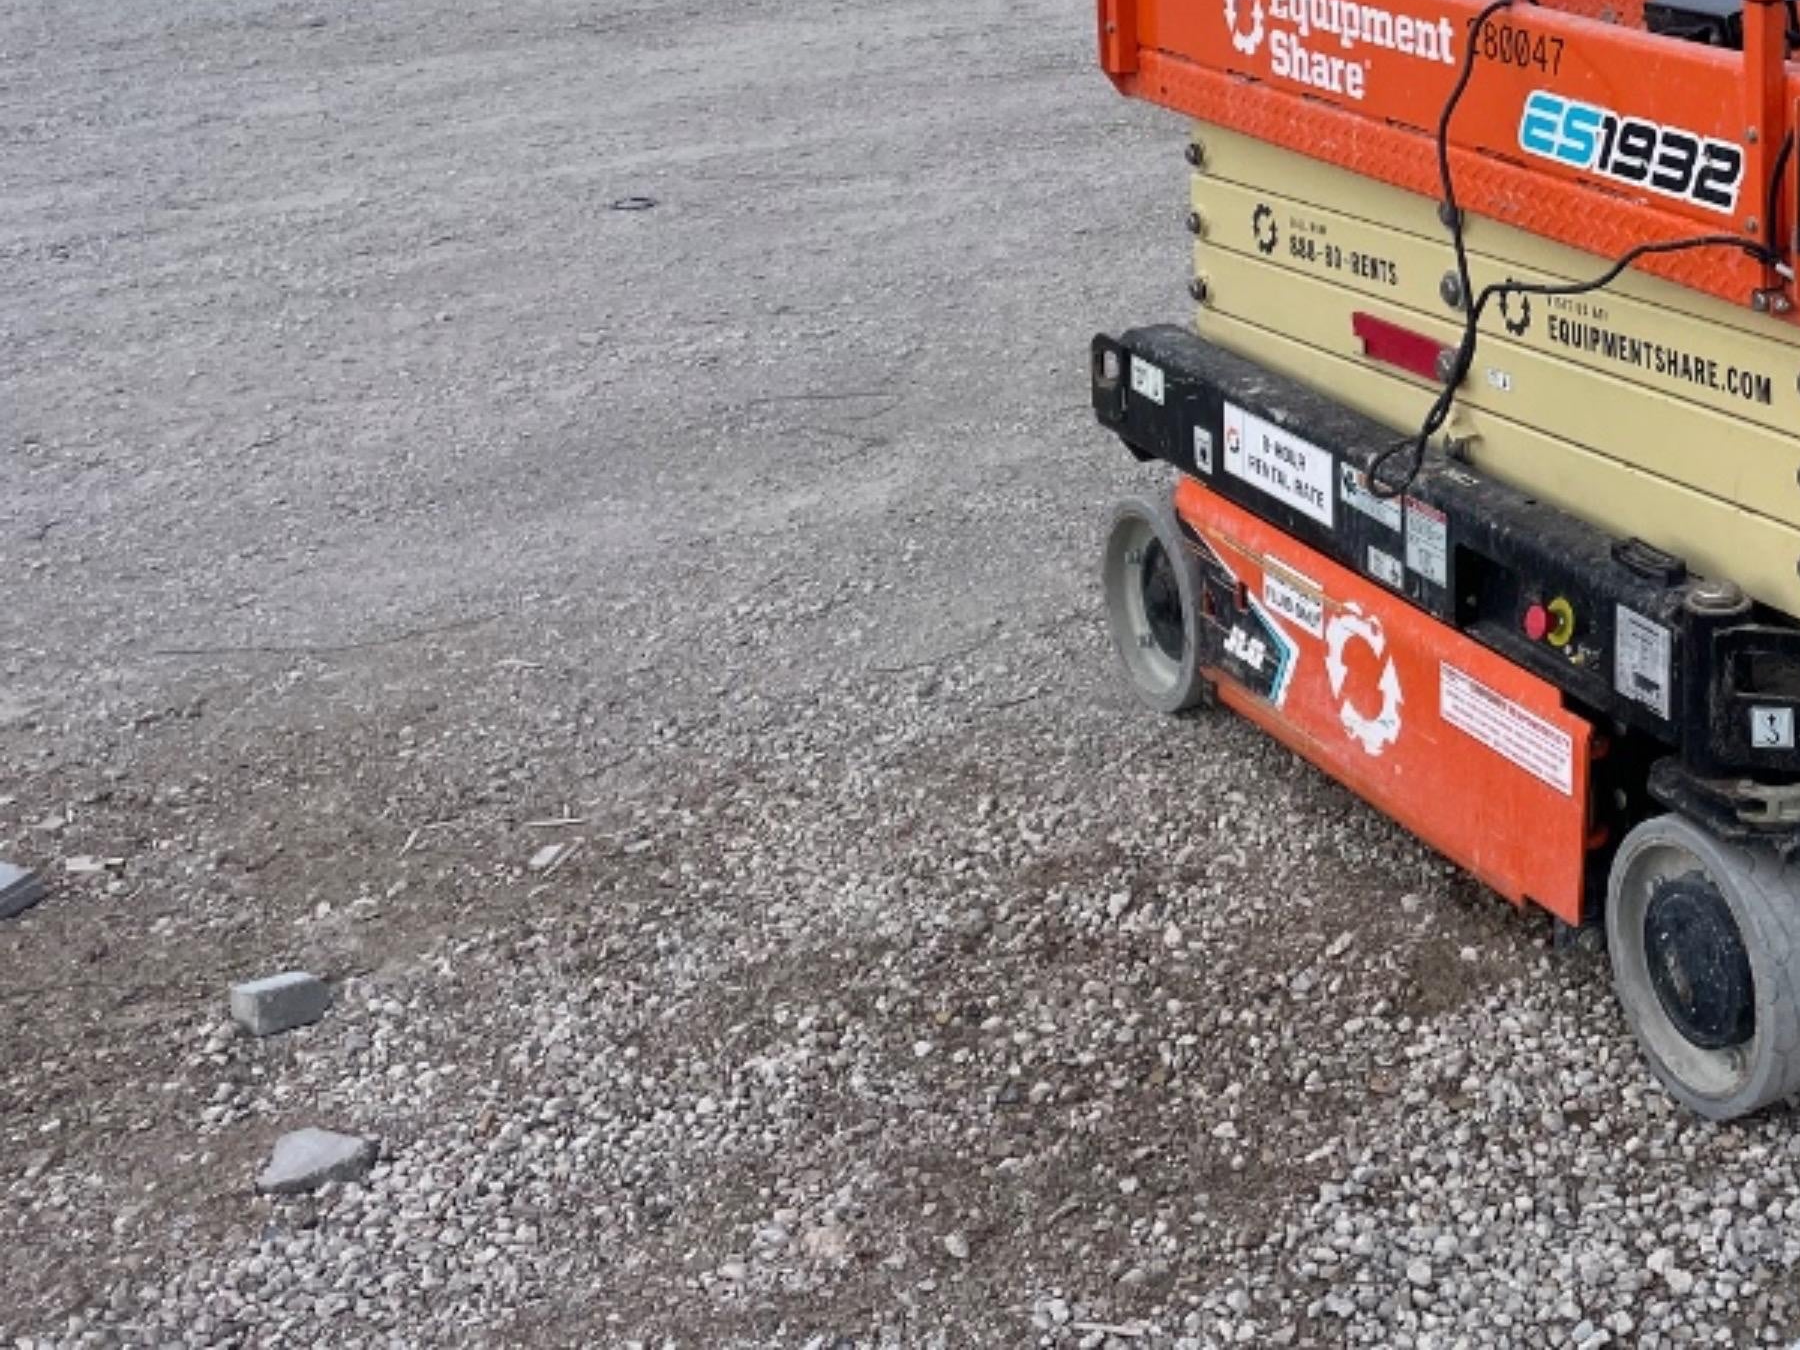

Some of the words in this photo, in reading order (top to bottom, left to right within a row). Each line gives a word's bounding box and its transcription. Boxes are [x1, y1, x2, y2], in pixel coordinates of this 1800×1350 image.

[1268, 29, 1366, 100] Share
[1520, 90, 1743, 213] ES1932
[1548, 315, 1772, 405] EQUIPMENTSHARE.COM
